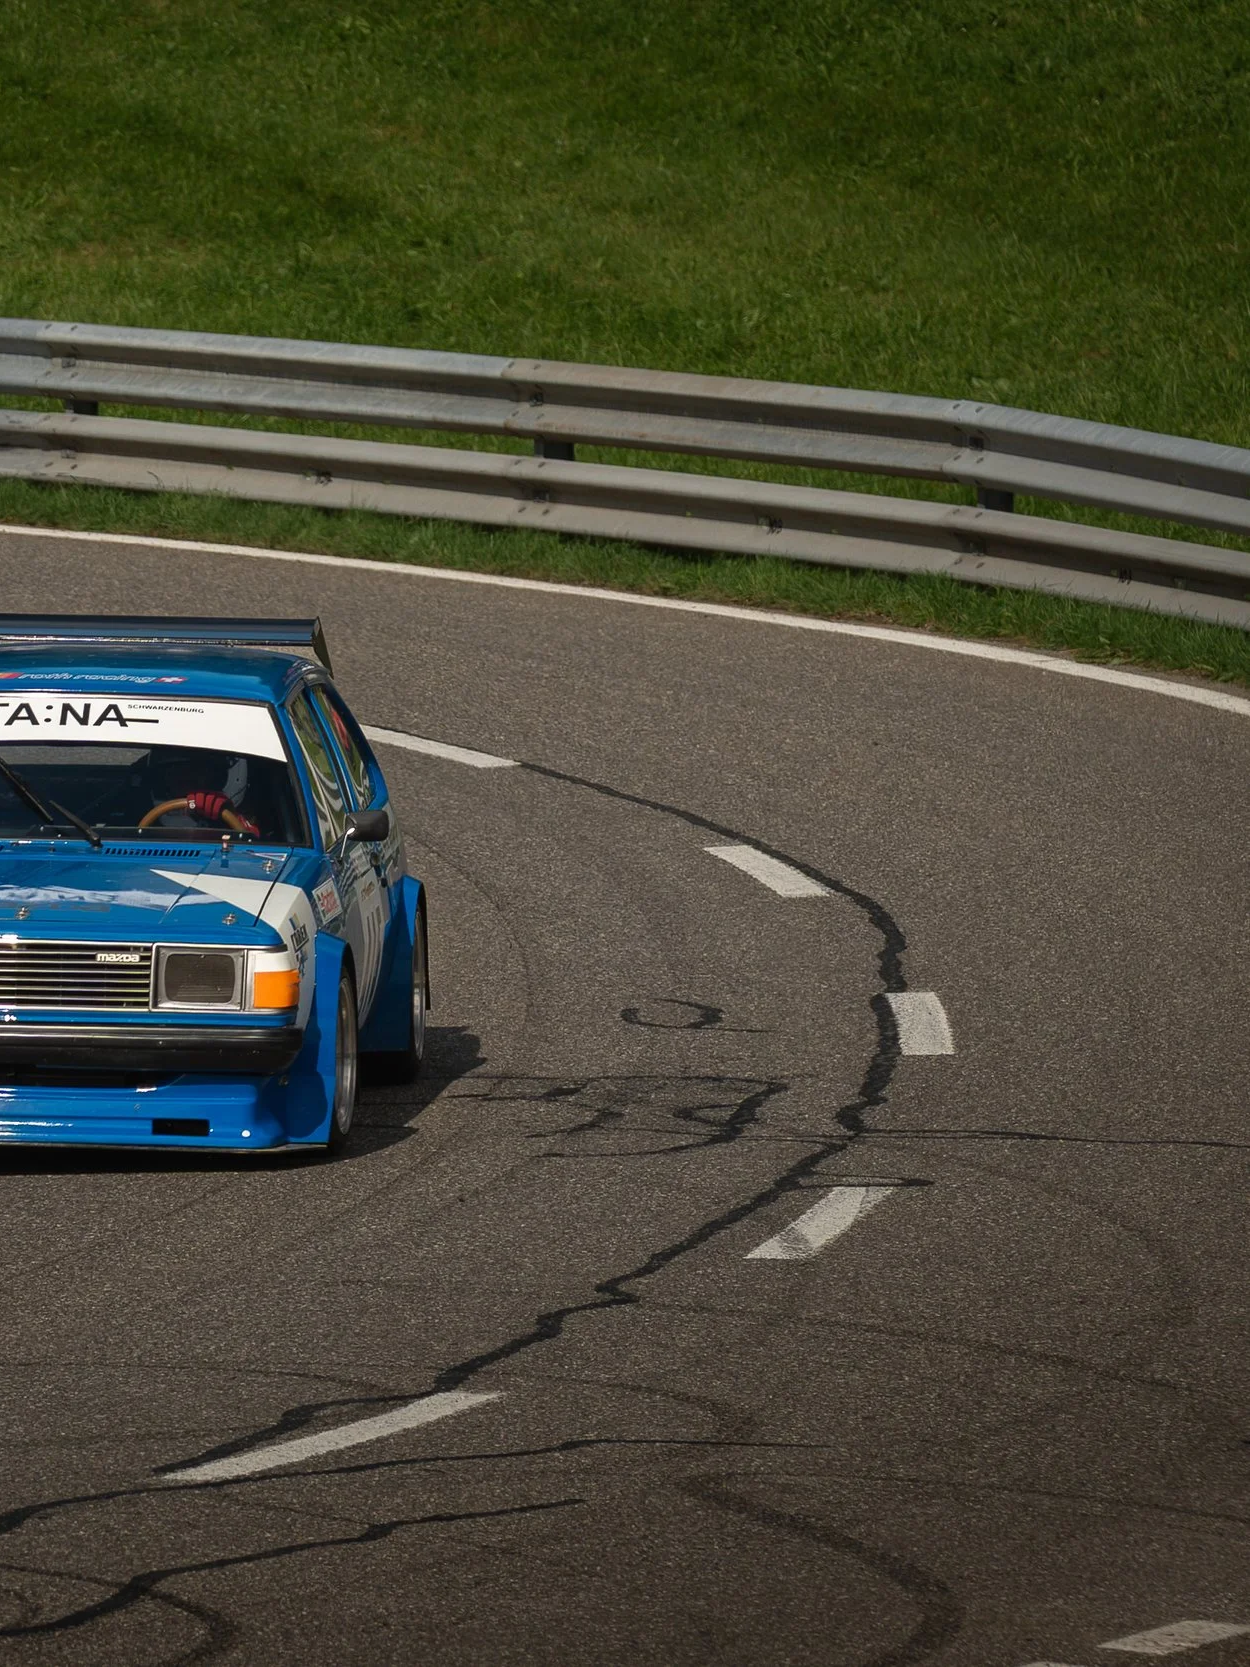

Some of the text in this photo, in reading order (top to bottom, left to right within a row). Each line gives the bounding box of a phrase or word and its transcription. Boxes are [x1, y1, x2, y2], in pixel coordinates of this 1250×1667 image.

[73, 674, 156, 684] racing
[128, 704, 204, 713] SCHWARZENBURG
[96, 953, 140, 963] mazda
